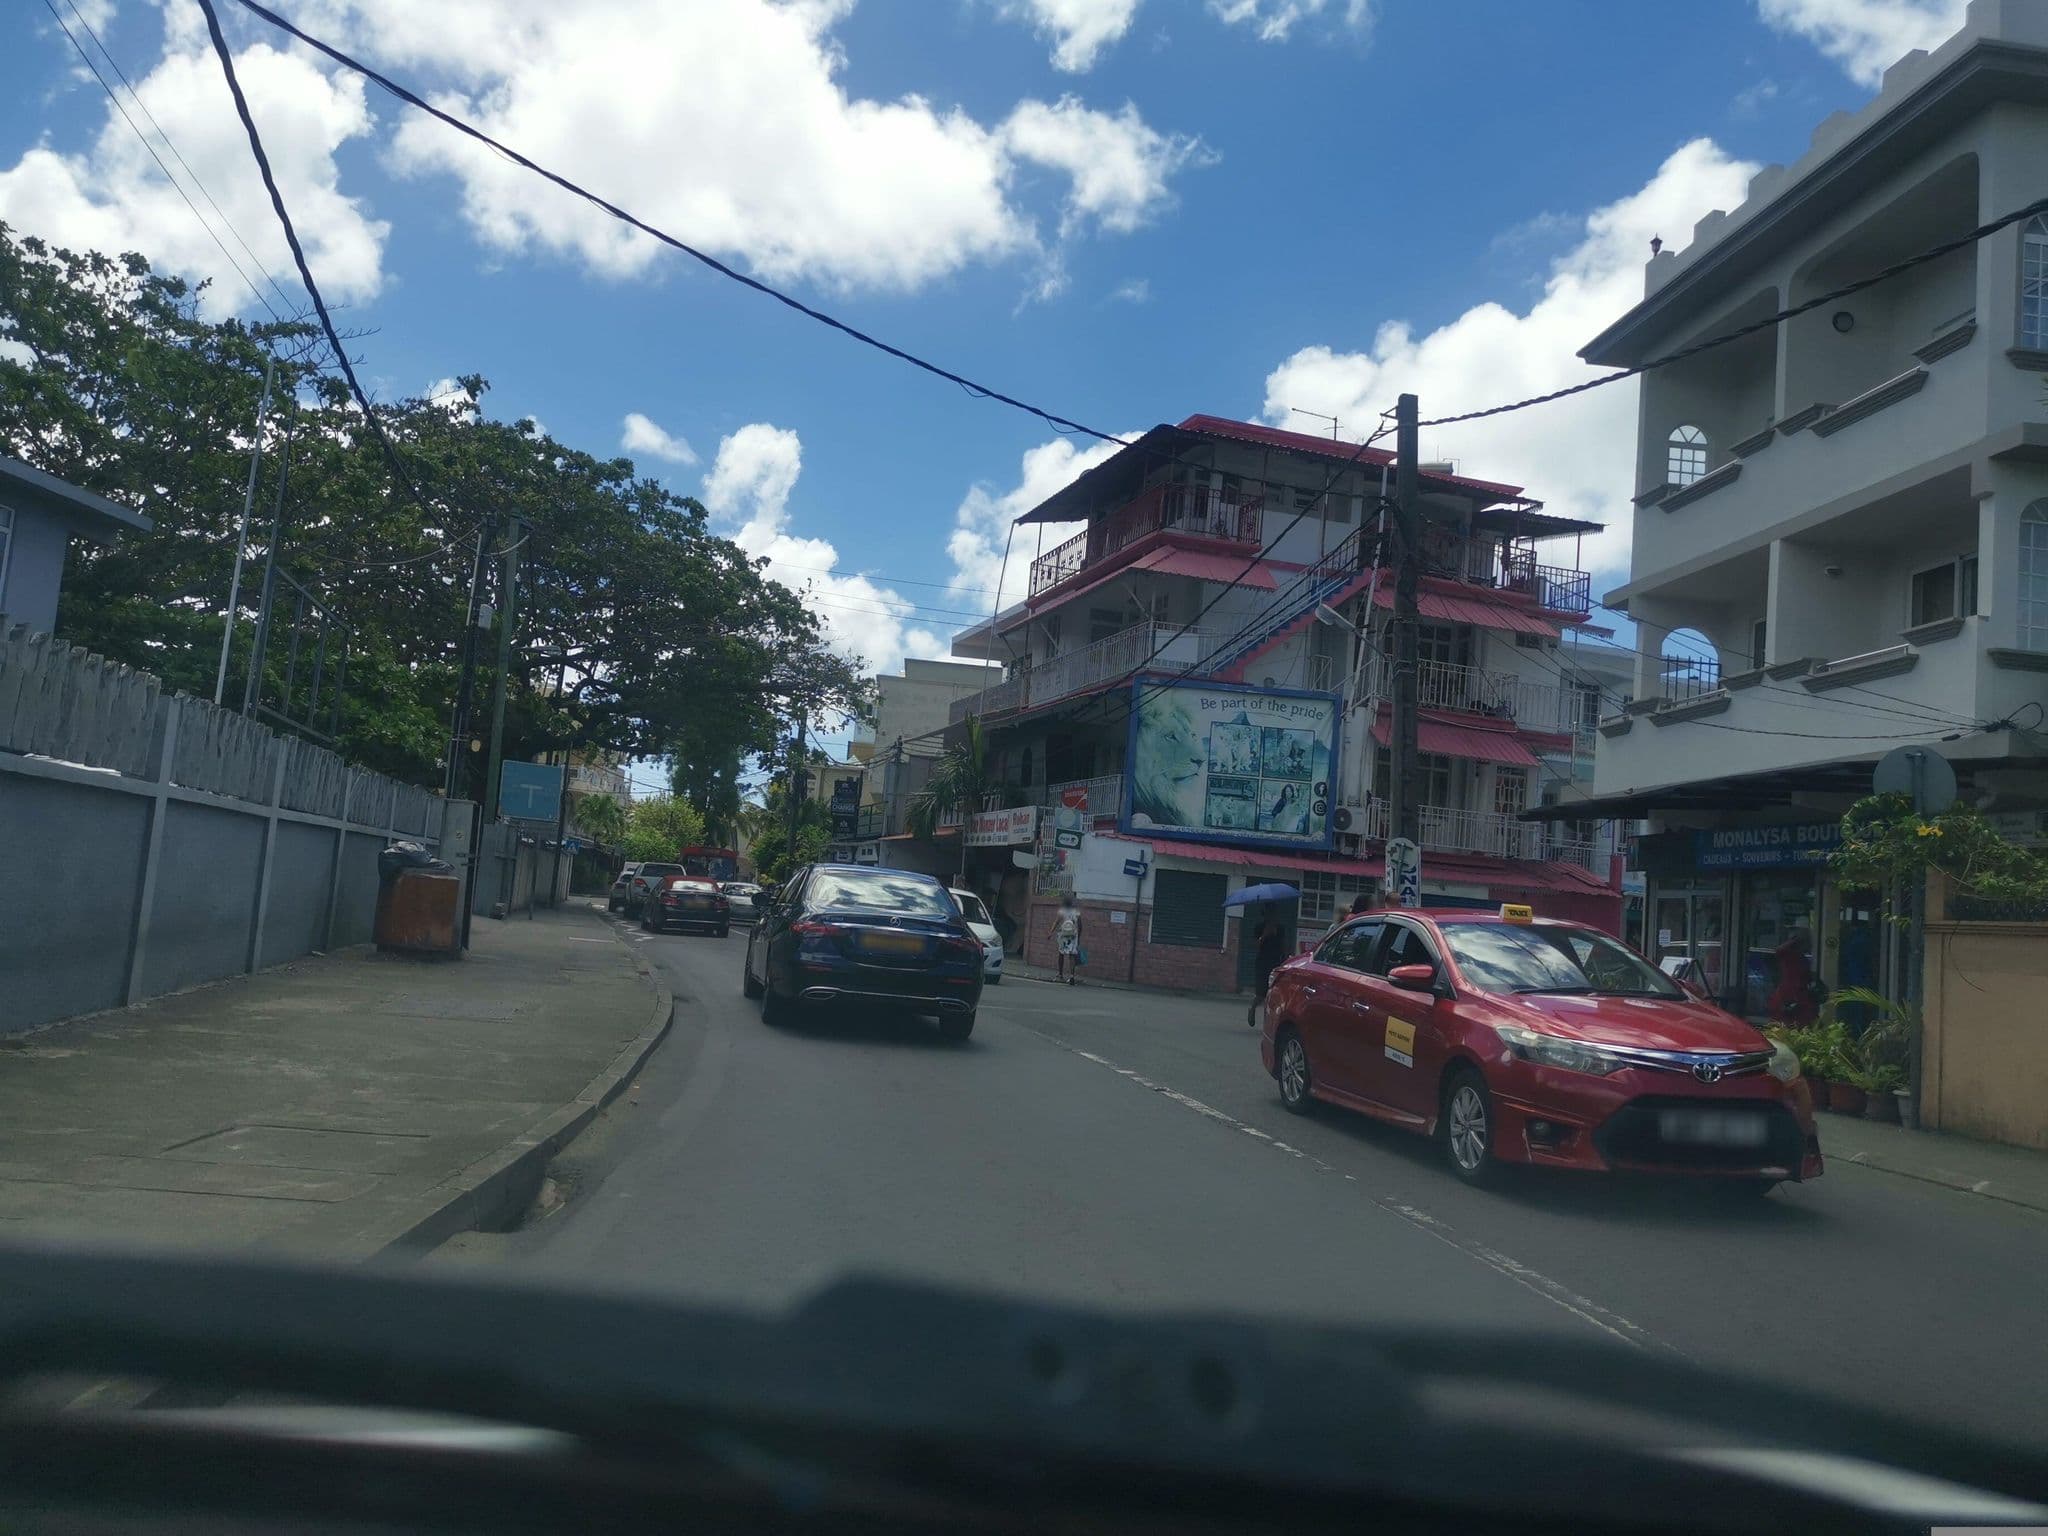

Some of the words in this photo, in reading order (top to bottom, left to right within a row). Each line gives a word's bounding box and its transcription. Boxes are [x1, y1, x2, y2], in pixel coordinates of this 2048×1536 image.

[1200, 697, 1217, 710] Be
[1221, 698, 1248, 711] part
[1250, 698, 1264, 710] of
[1267, 699, 1288, 712] the
[1290, 704, 1325, 720] pride
[1713, 827, 1790, 849] MONALYSA
[1508, 909, 1529, 917] TAXI
